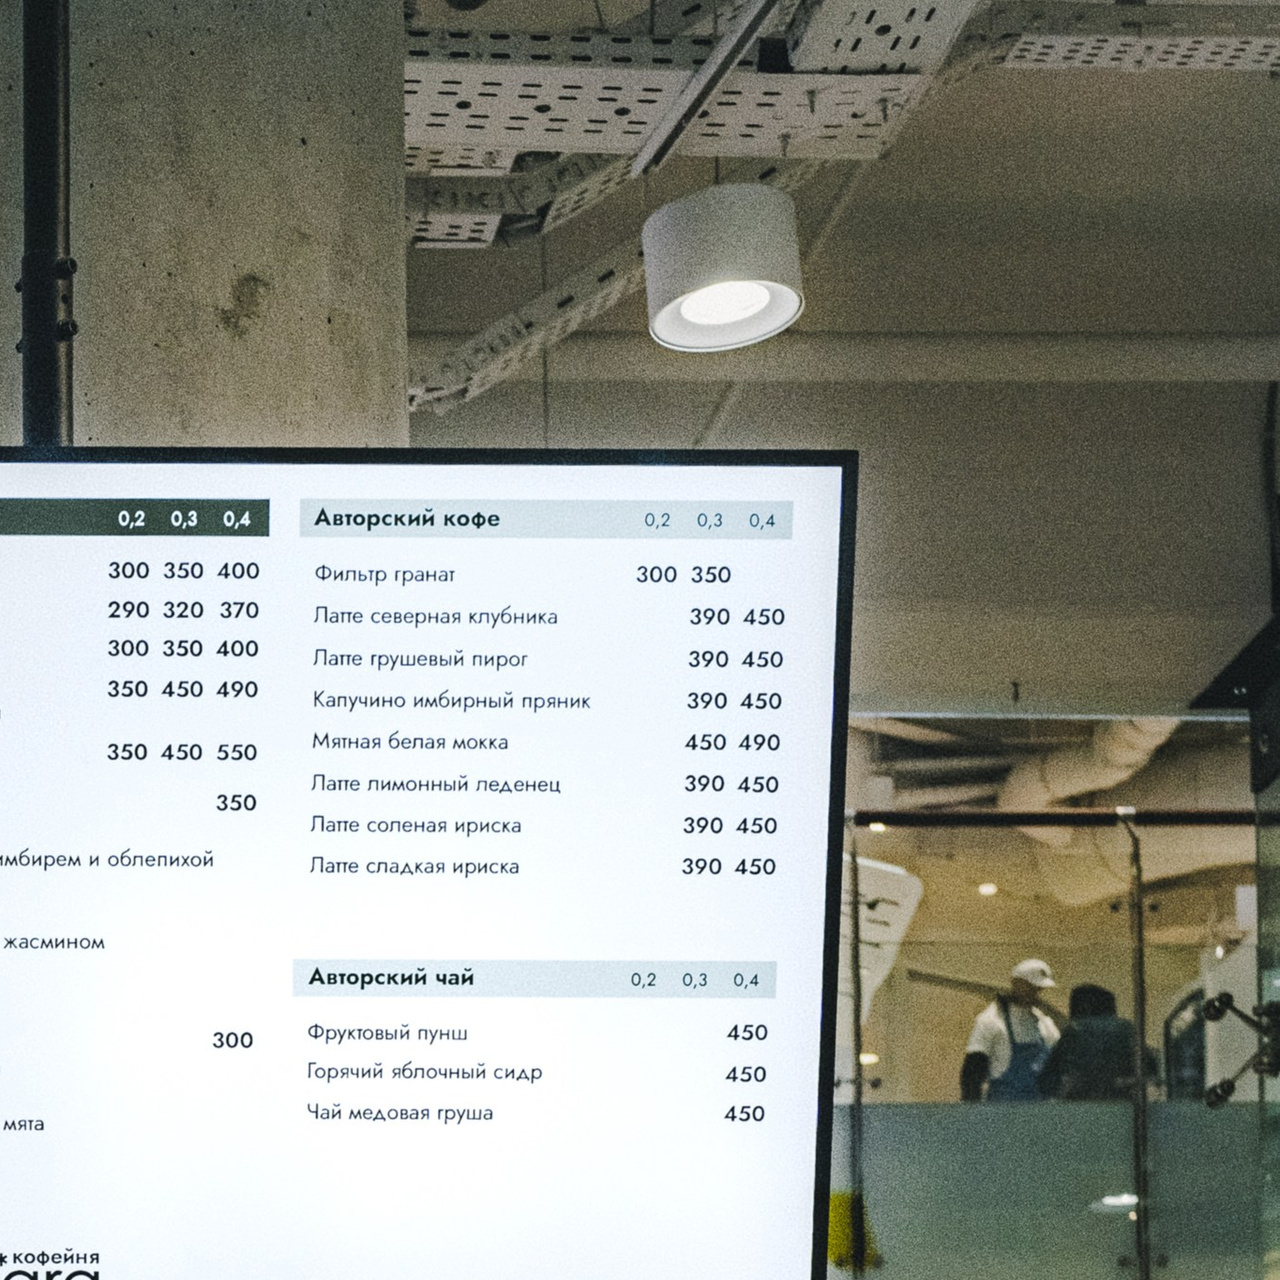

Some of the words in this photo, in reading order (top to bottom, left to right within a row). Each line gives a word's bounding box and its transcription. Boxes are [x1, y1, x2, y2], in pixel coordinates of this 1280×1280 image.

[118, 510, 146, 529] 0,2
[170, 510, 198, 529] 0,3
[223, 510, 251, 530] 0,4
[314, 507, 435, 532] Авторский
[443, 511, 500, 529] кофе
[644, 512, 670, 527] 0,2
[697, 512, 723, 529] 0,3
[749, 513, 776, 530] 0,4
[108, 600, 150, 619] 290
[163, 600, 204, 619] 320
[220, 601, 259, 619] 370
[314, 605, 364, 624] Латте
[370, 611, 461, 628] северная
[468, 605, 558, 629] клубника
[690, 607, 731, 626] 390
[743, 608, 786, 626] 450
[312, 732, 381, 749] Мятная
[388, 730, 446, 750] белая
[452, 737, 509, 750] мокка
[685, 733, 727, 751] 450
[738, 733, 781, 752] 490
[89, 855, 100, 866] и
[107, 848, 214, 868] облепихой
[307, 1061, 383, 1083] Горячий
[392, 1060, 486, 1080] яблочный
[493, 1067, 543, 1084] сидр
[725, 1065, 767, 1083] 450
[12, 1248, 100, 1267] кофейня
